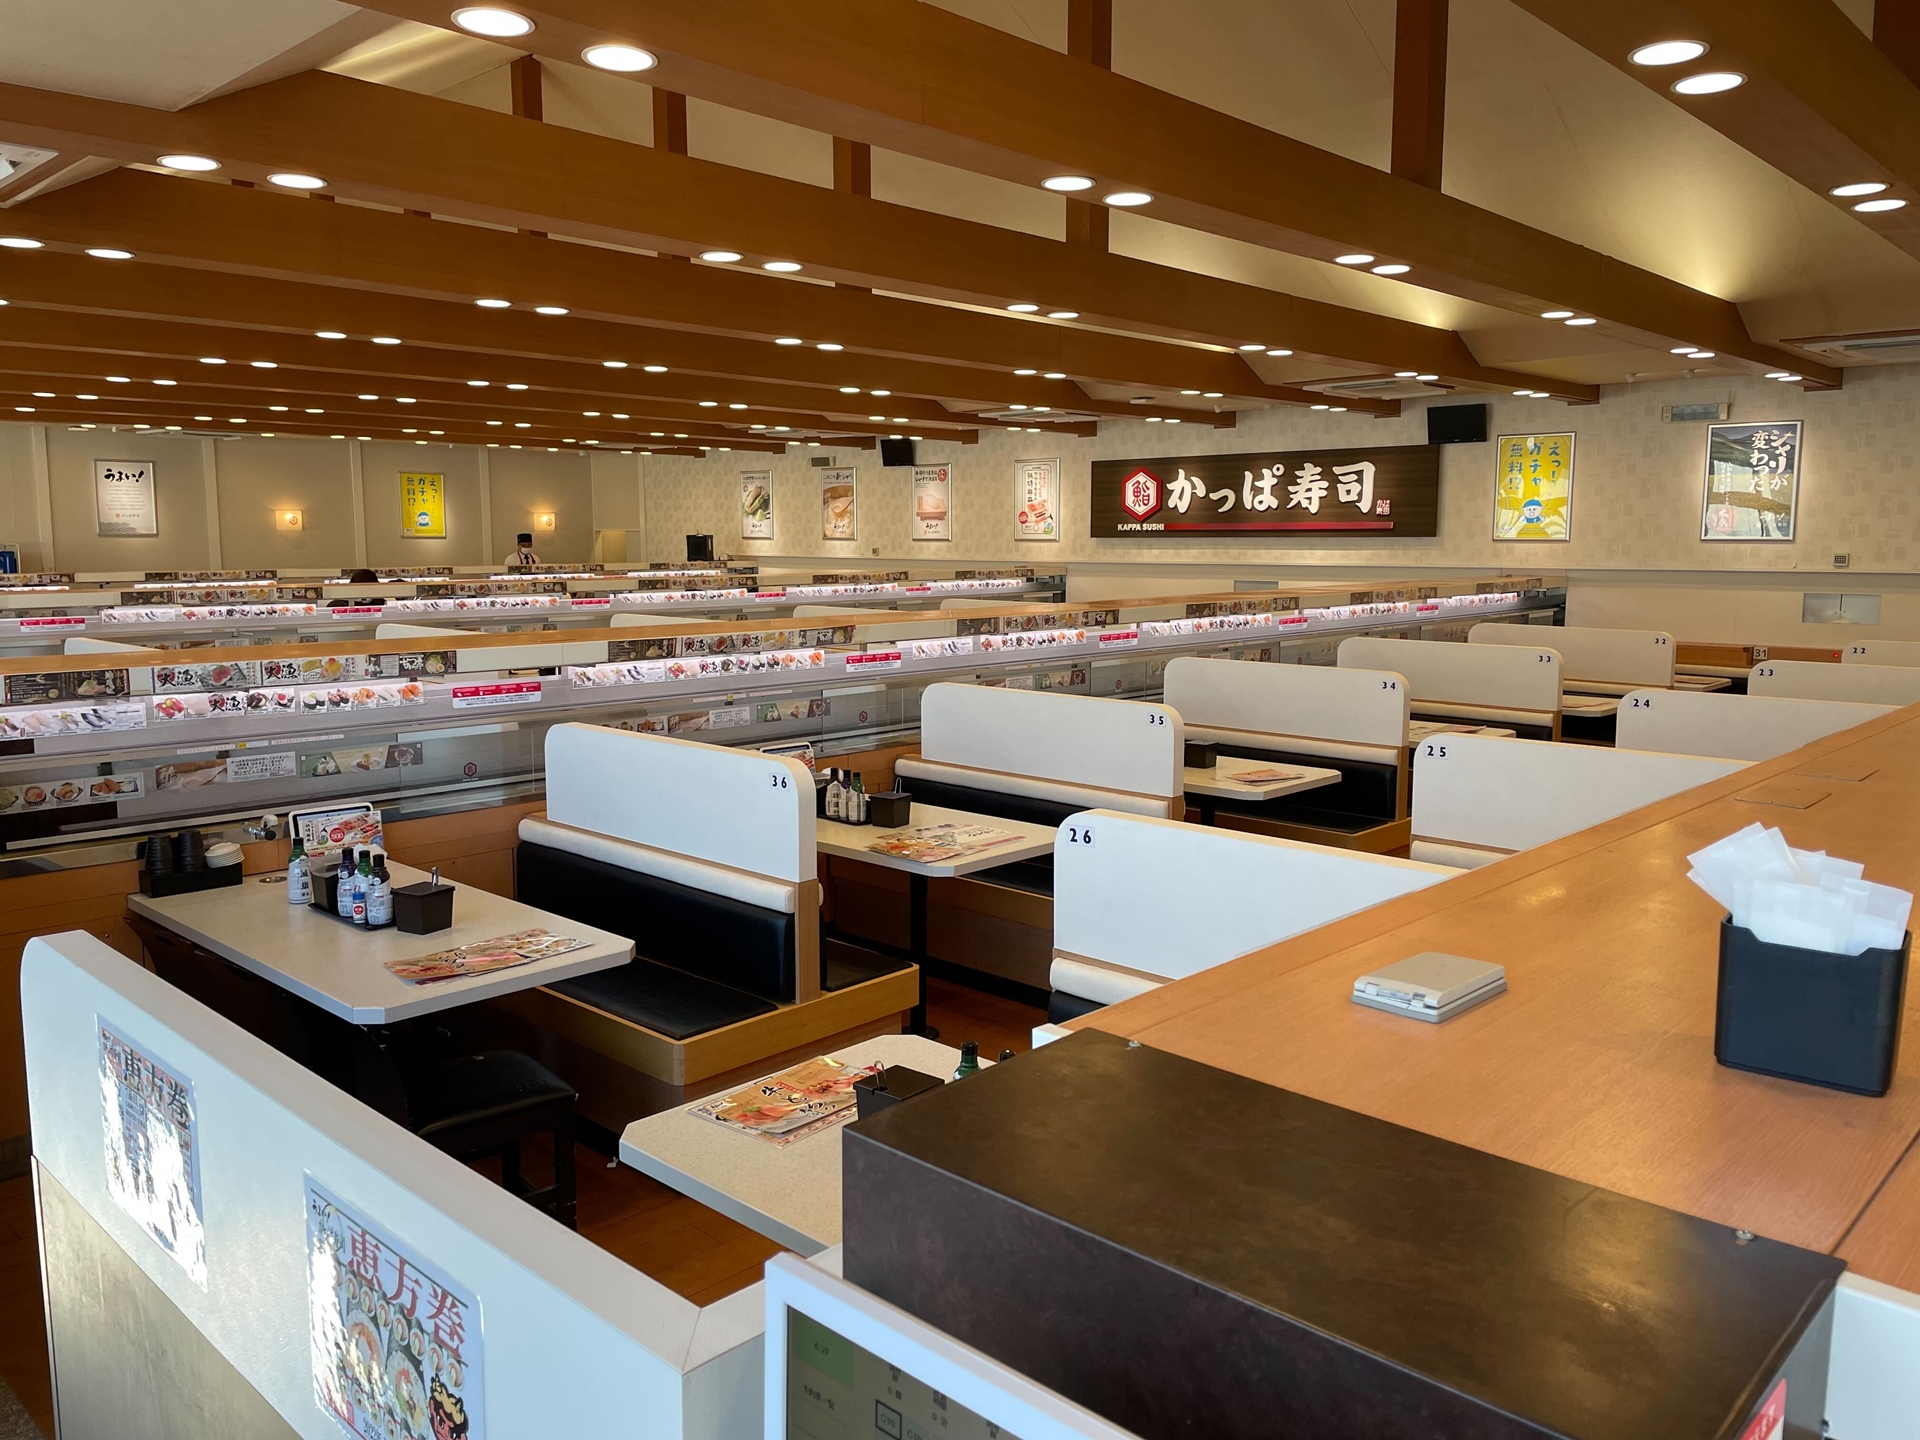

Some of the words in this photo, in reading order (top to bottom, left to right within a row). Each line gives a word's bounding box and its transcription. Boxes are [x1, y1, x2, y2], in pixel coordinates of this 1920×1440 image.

[1529, 442, 1544, 487] ガチャ
[1749, 430, 1770, 491] 変わった
[1769, 429, 1795, 491] シャリが
[104, 468, 145, 483] うまい!
[417, 476, 428, 504] ガチャ
[1165, 460, 1377, 515] かっぱ寿司
[1117, 523, 1141, 531] KAPPA
[1142, 523, 1165, 531] SUSHI
[1753, 648, 1767, 659] 31
[1759, 668, 1774, 677] 23
[1382, 681, 1396, 690] 34
[1633, 698, 1650, 708] 24
[1149, 714, 1164, 726] 35
[1427, 745, 1446, 758] 25
[772, 775, 787, 789] 36
[331, 832, 344, 840] 500
[1069, 827, 1092, 845] 26
[122, 1047, 189, 1130] 恵方巻
[346, 1224, 467, 1360] 恵方巻
